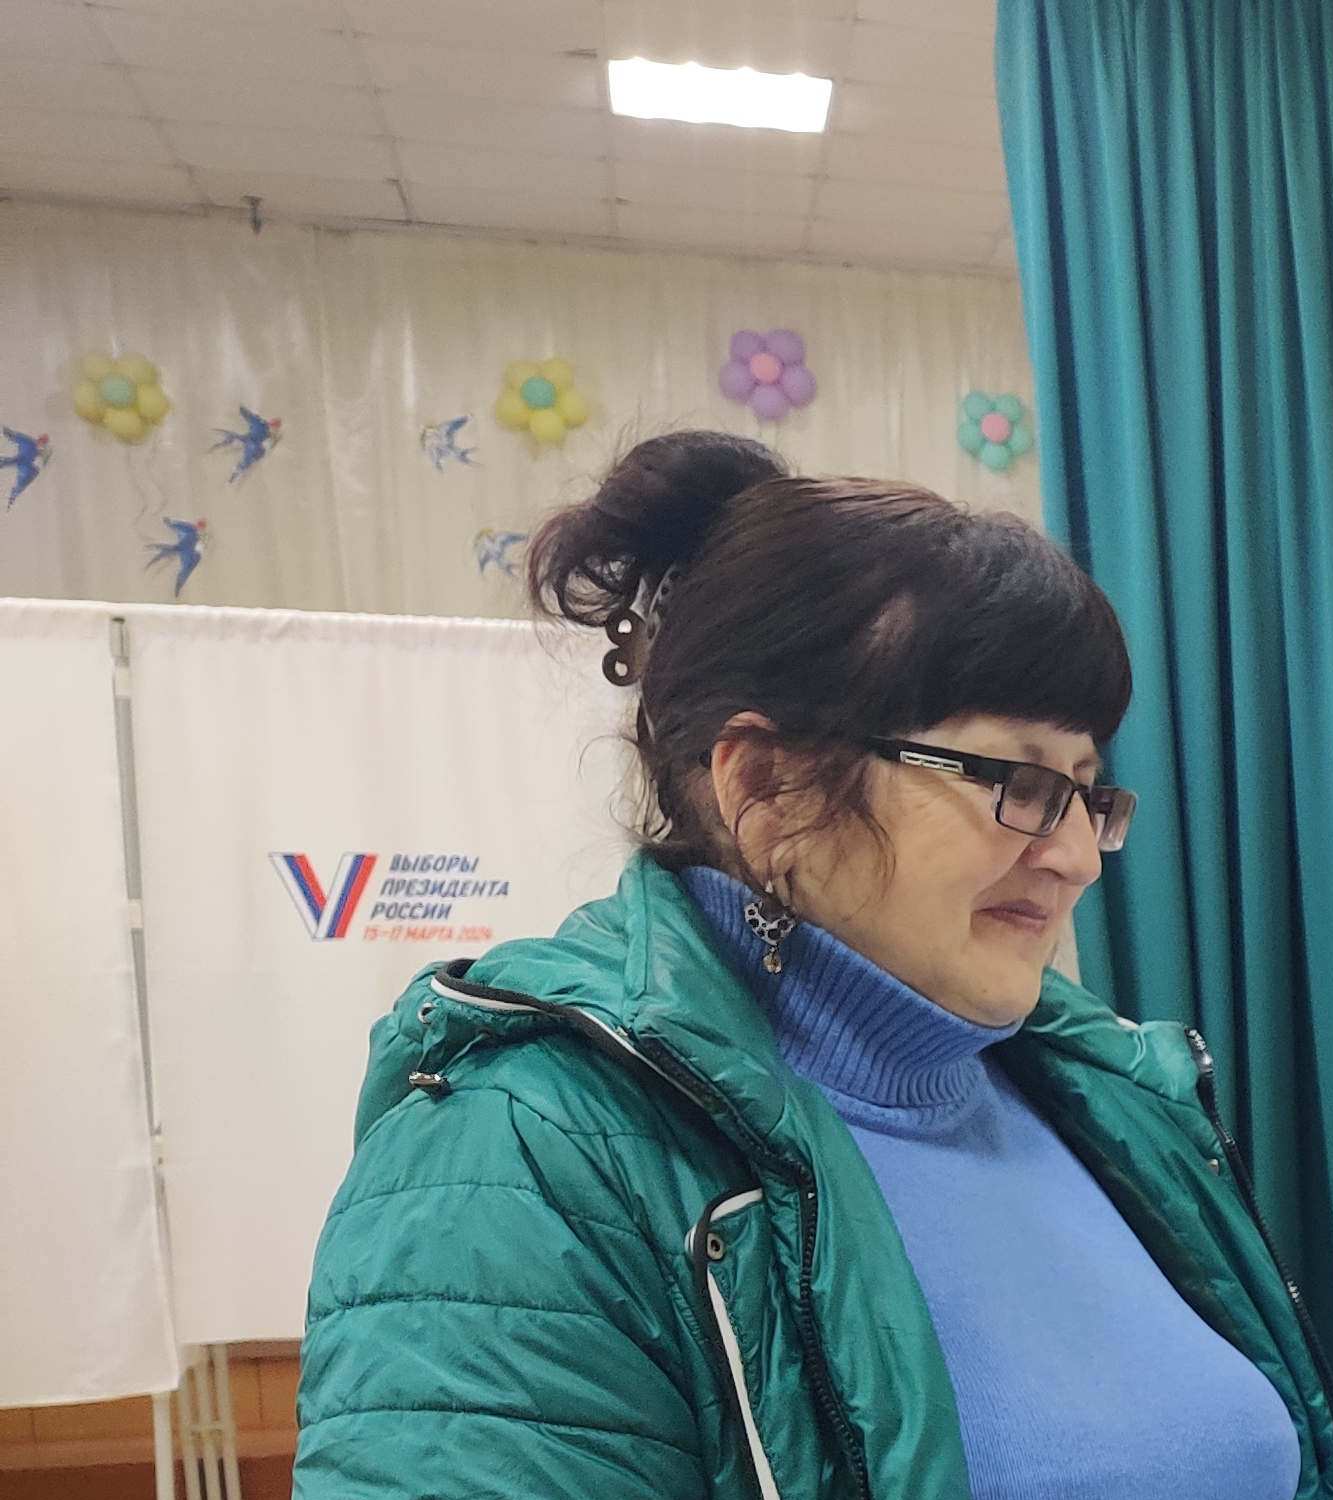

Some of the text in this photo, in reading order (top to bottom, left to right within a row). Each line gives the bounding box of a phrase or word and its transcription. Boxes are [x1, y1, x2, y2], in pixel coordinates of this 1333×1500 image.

[389, 854, 480, 873] ВЫБОРЫ
[380, 878, 510, 897] ПРЕЗИДЕНТА
[371, 902, 453, 920] РОССИИ
[403, 926, 454, 940] МАРТА
[457, 926, 493, 940] 2024
